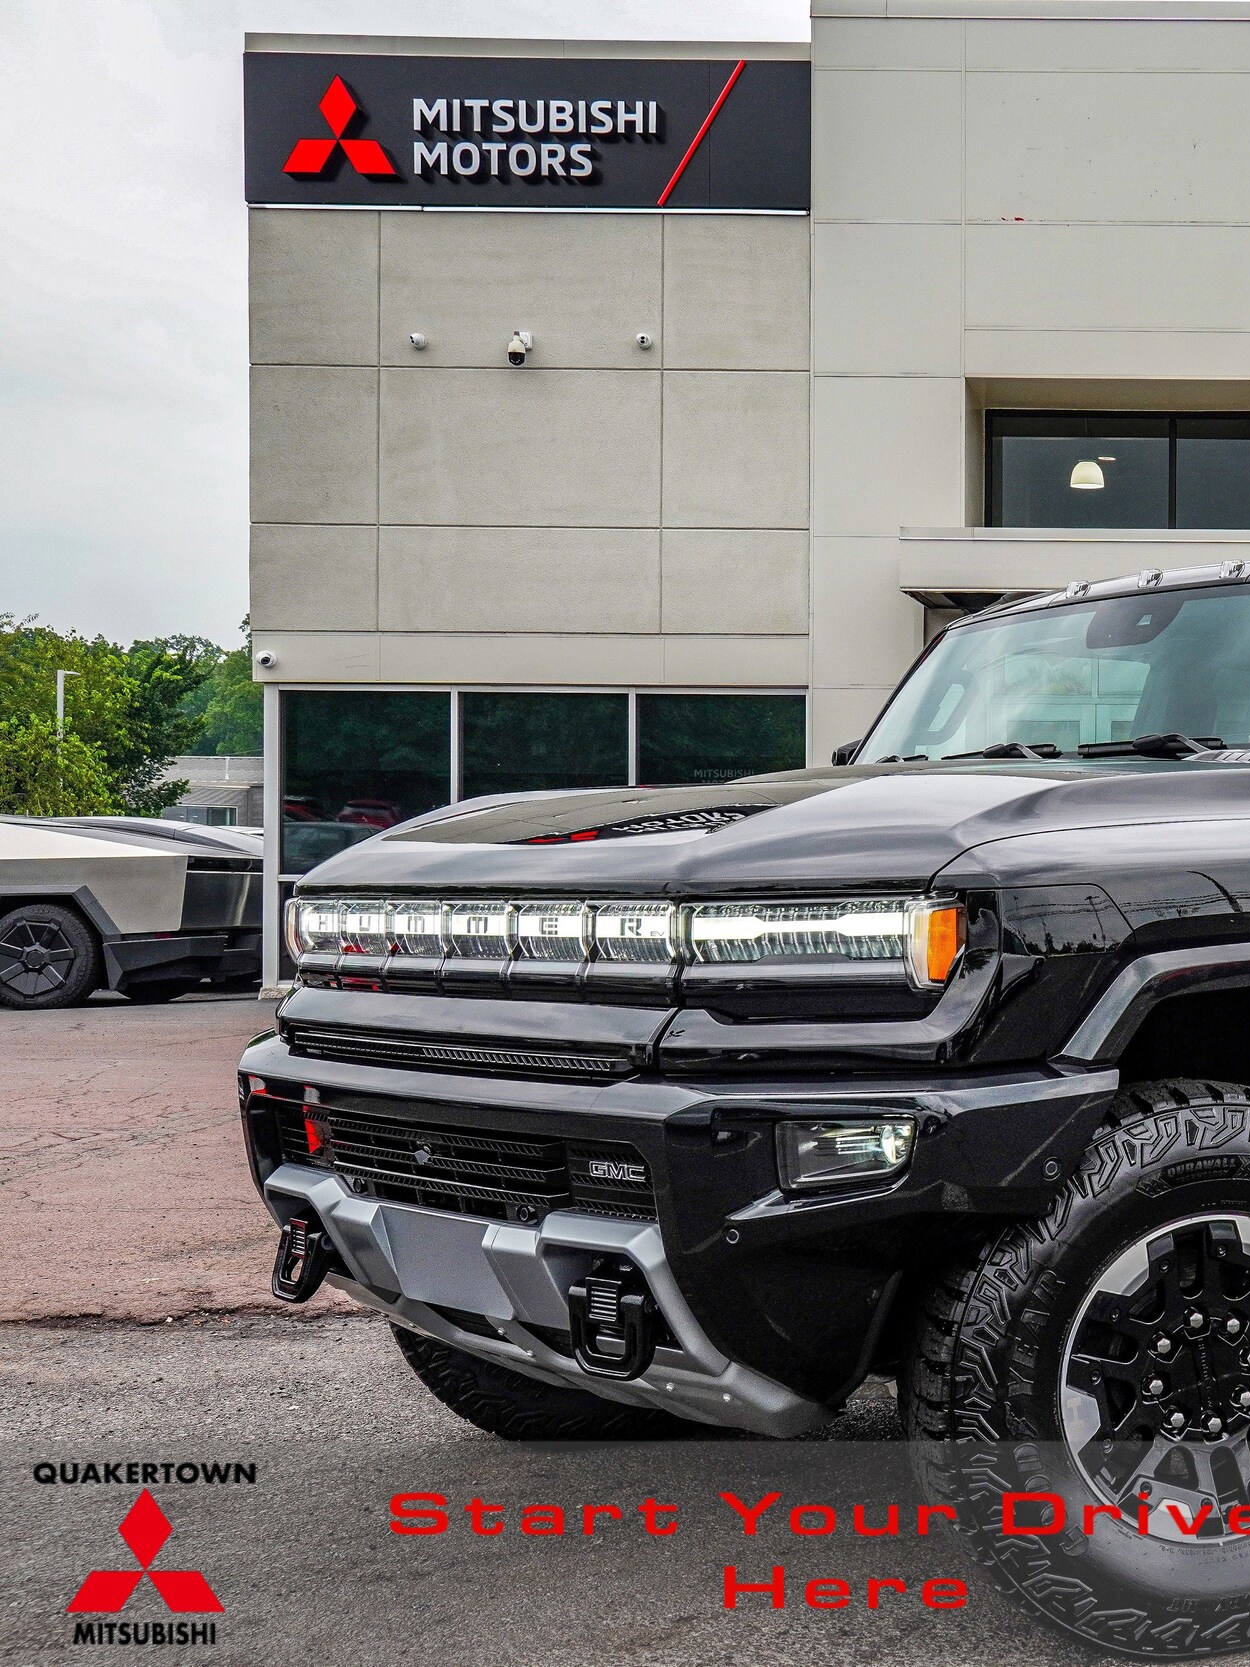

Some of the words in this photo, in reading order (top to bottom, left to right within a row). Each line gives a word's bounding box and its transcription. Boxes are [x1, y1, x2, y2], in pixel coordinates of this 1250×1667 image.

[413, 98, 657, 134] MITSUBISHI
[413, 141, 593, 177] MOTORS
[317, 913, 642, 937] HUMMER
[589, 1160, 646, 1182] GMC
[1167, 1157, 1236, 1178] DURAWALL
